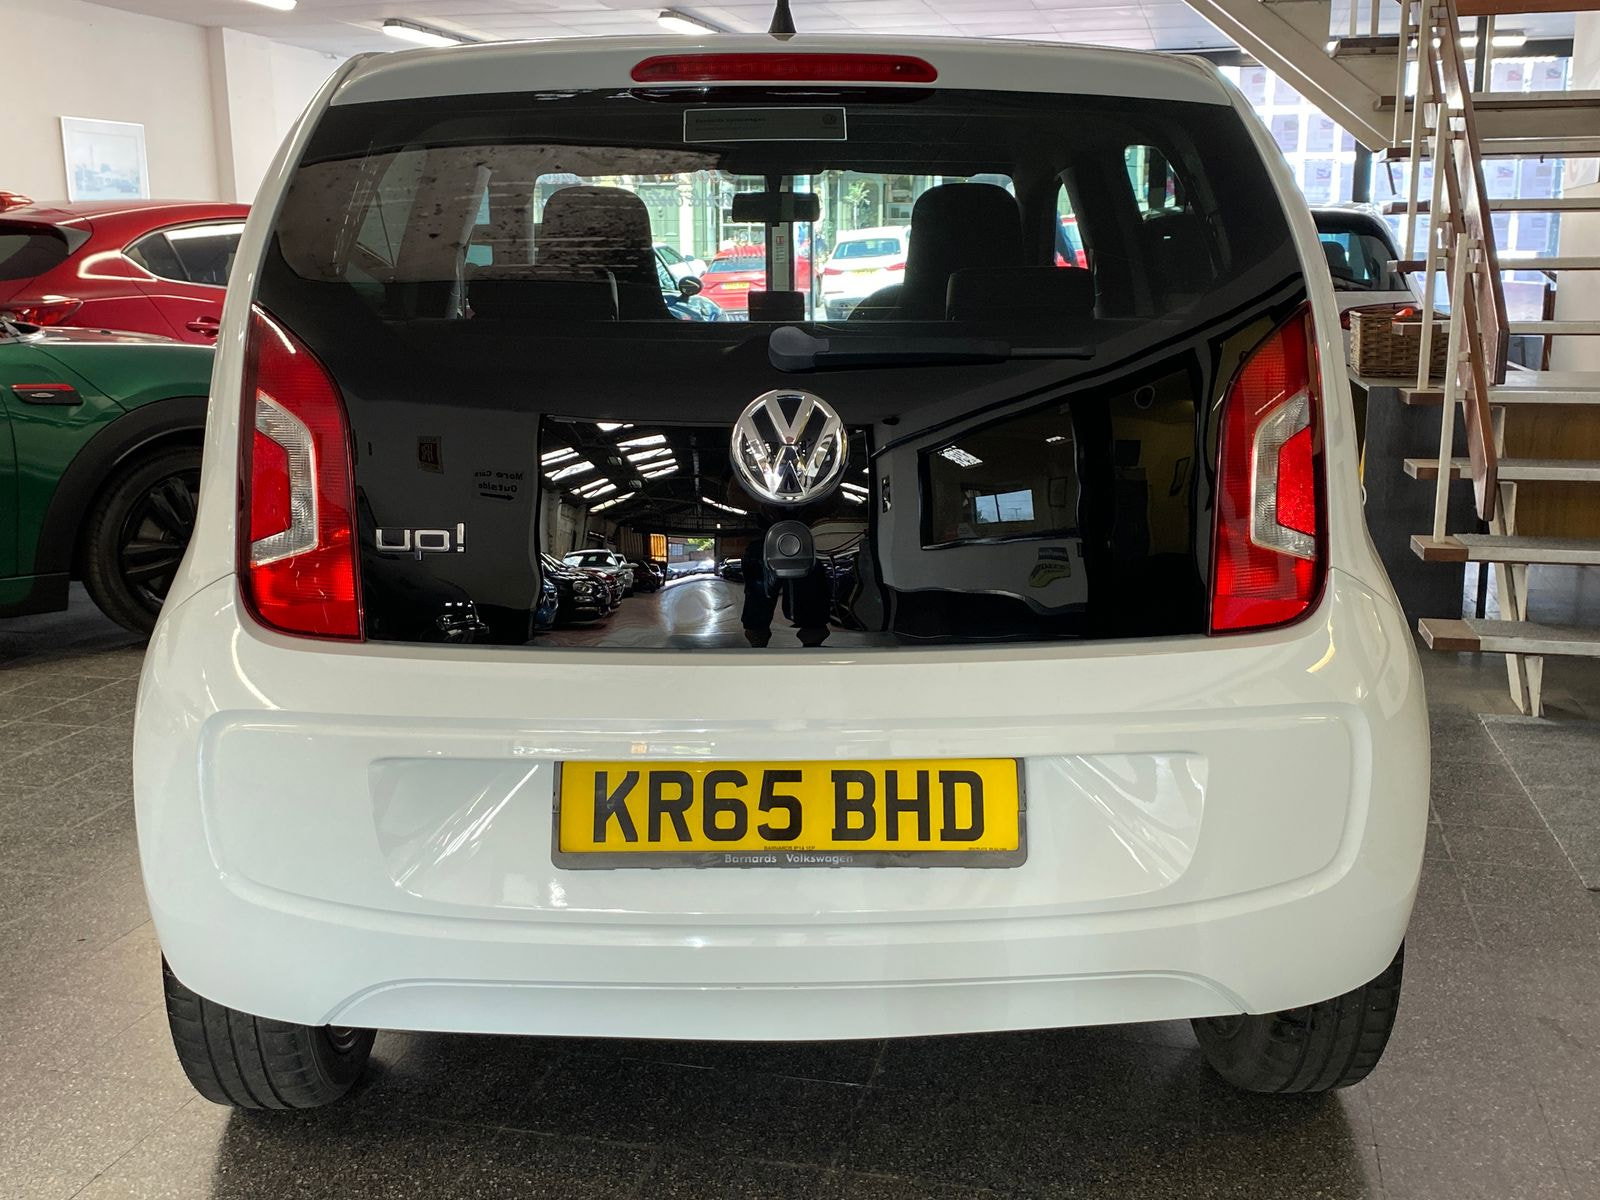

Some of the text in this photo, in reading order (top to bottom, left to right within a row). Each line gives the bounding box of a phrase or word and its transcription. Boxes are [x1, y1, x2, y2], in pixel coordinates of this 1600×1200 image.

[375, 522, 465, 560] up!
[593, 769, 985, 843] KR65 BHD
[724, 853, 854, 865] Barnards Volkswagen
